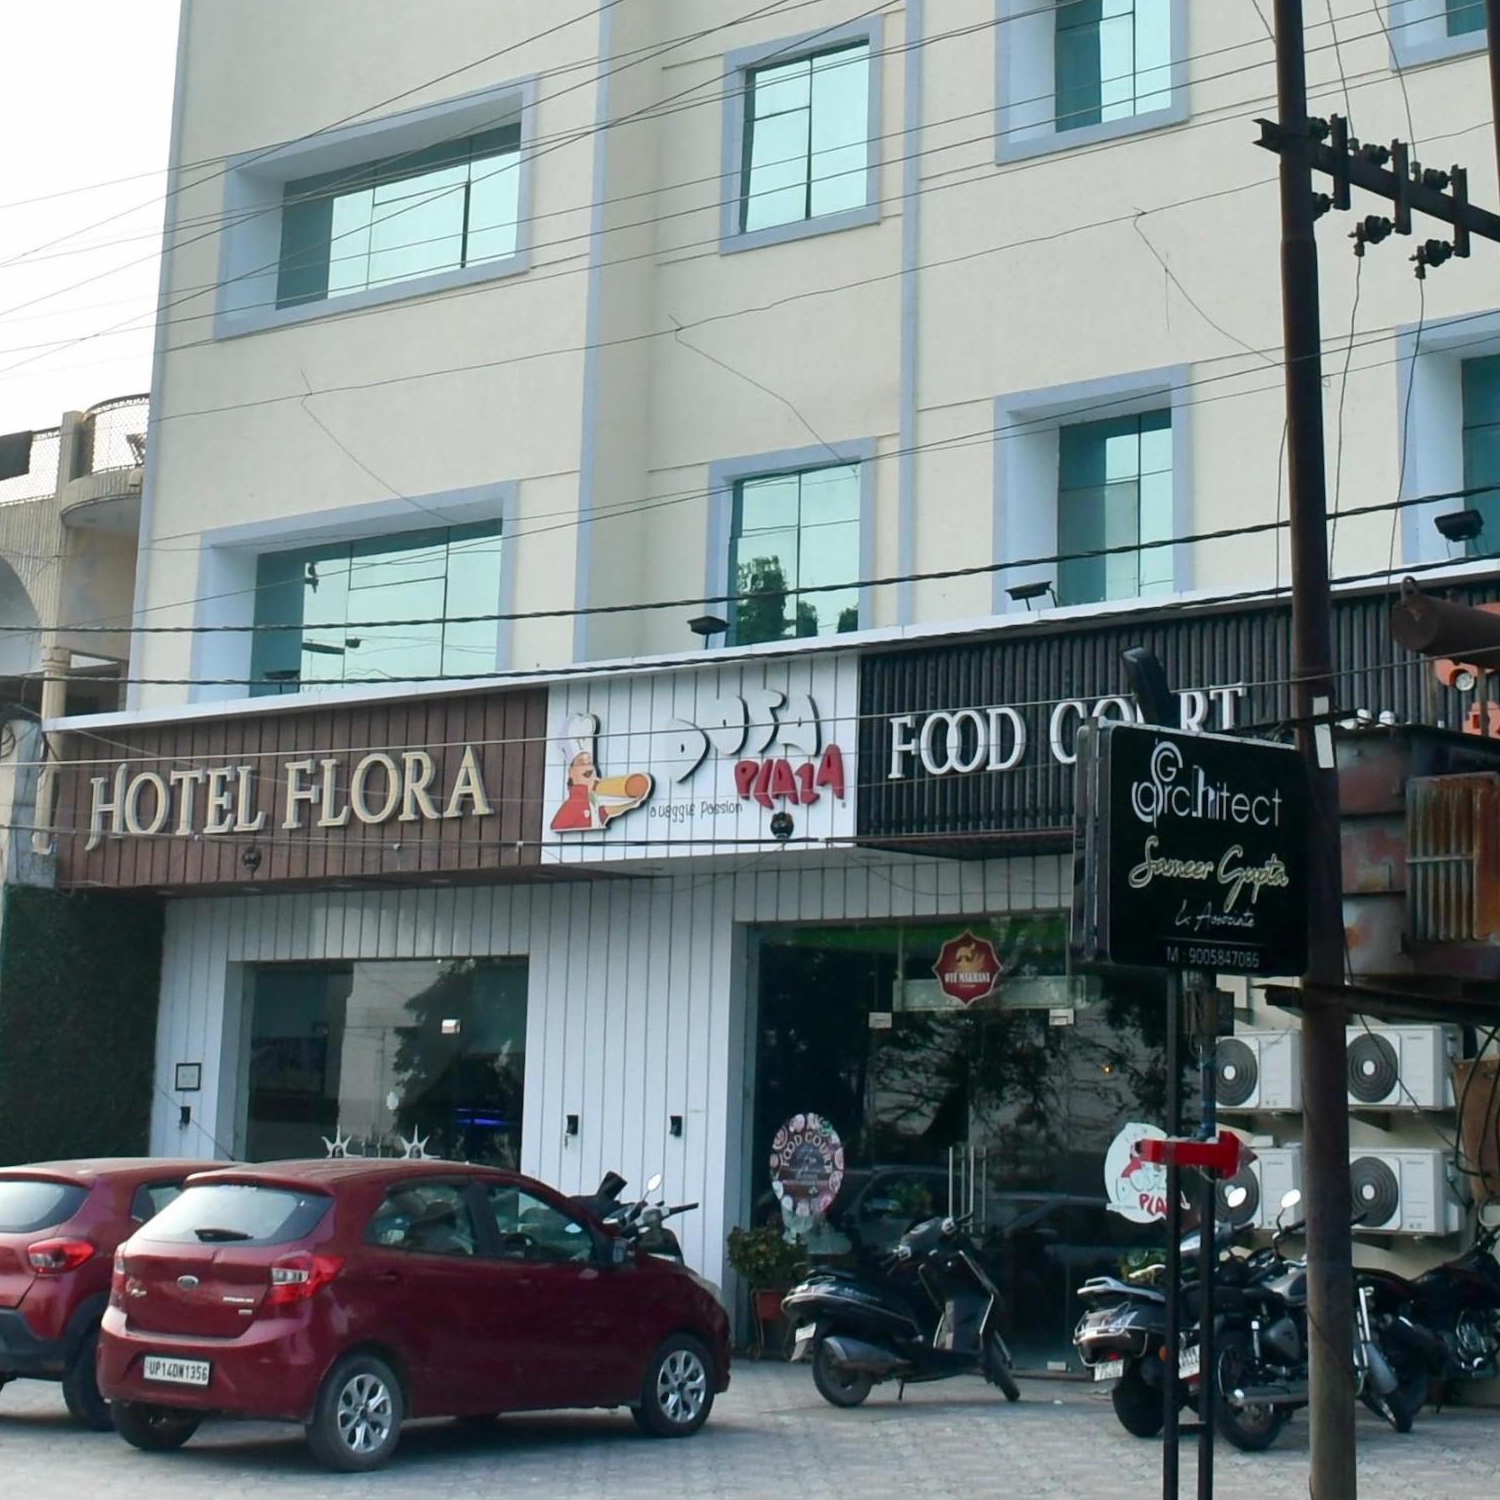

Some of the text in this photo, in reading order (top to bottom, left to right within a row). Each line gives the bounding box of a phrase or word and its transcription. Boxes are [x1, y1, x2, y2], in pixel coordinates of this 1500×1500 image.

[734, 743, 845, 810] PLAZA
[888, 706, 1027, 779] FOOD
[84, 746, 495, 851] HOTEL FLORA
[1129, 835, 1289, 913] Sameer Gupta
[149, 1361, 208, 1381] UP14DN1356
